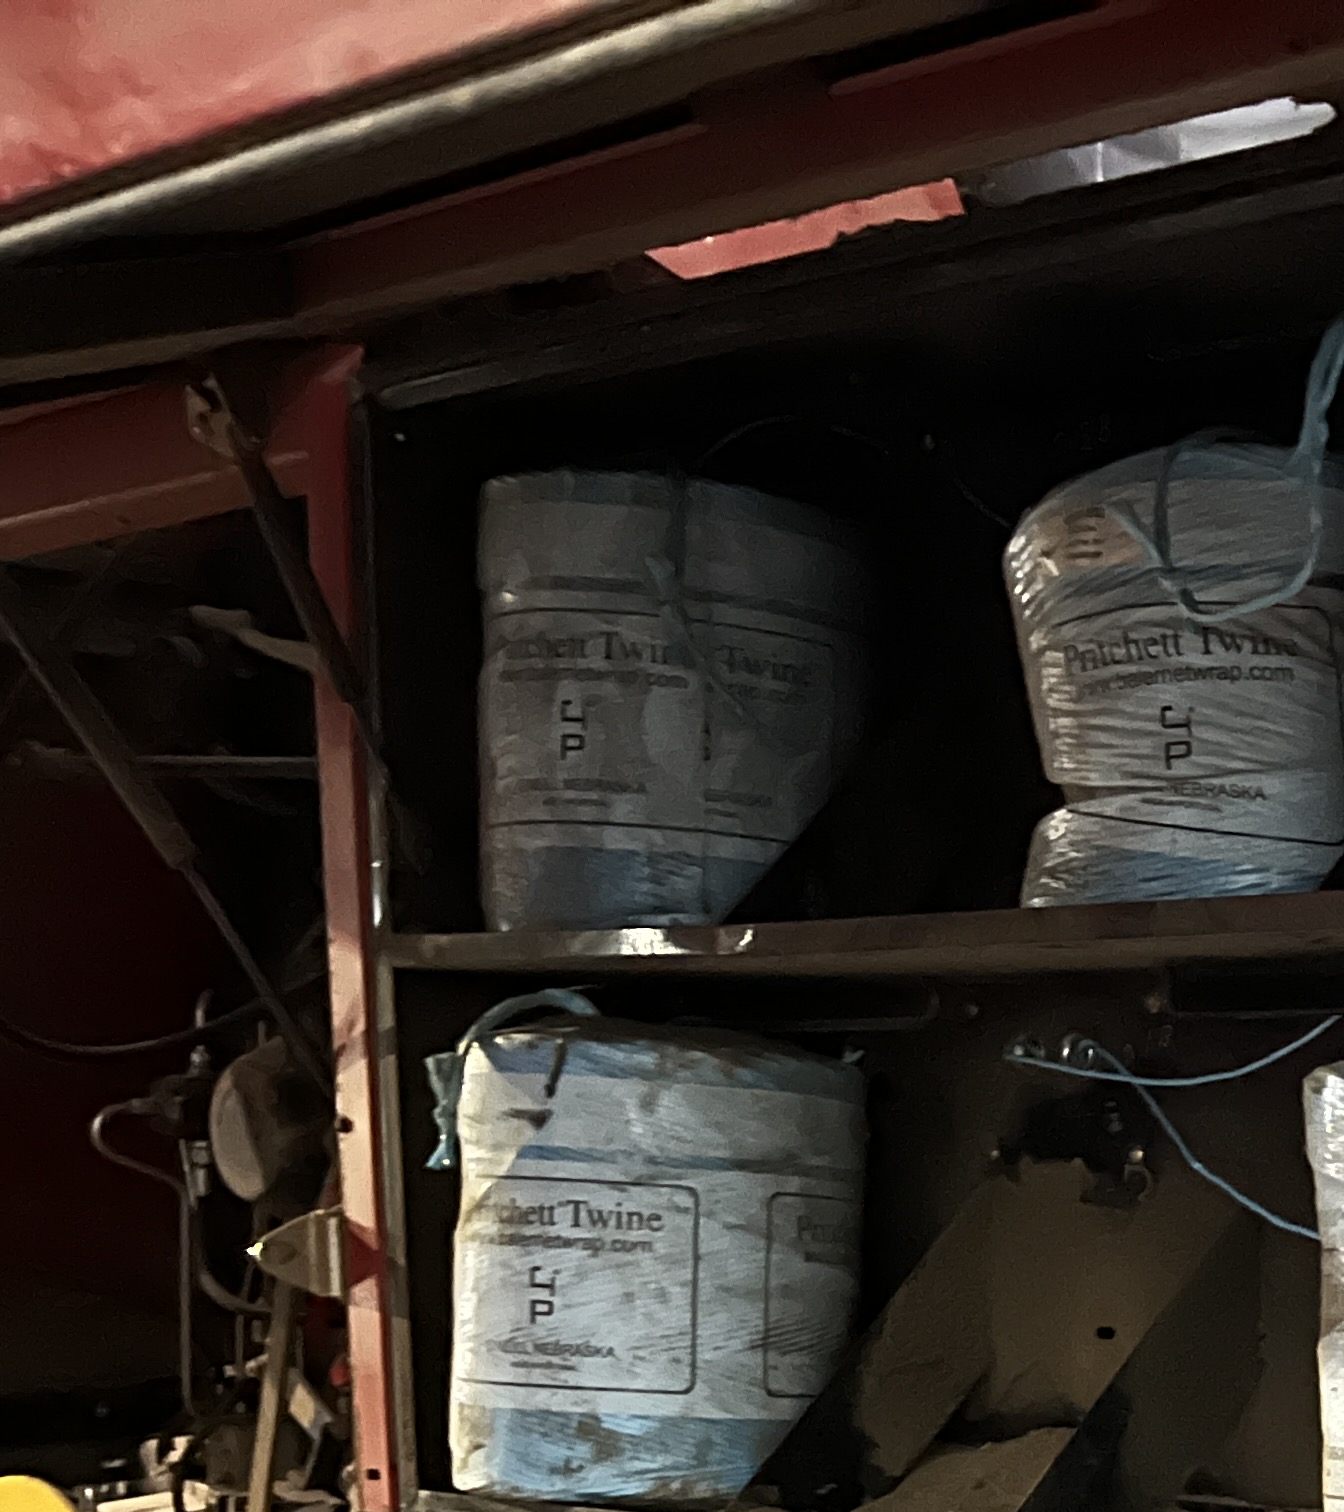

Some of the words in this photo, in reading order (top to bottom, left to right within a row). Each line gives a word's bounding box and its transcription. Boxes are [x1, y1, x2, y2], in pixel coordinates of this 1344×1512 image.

[1063, 629, 1185, 675] Pritchett
[1202, 626, 1299, 657] Twine
[565, 1199, 664, 1232] Twine
